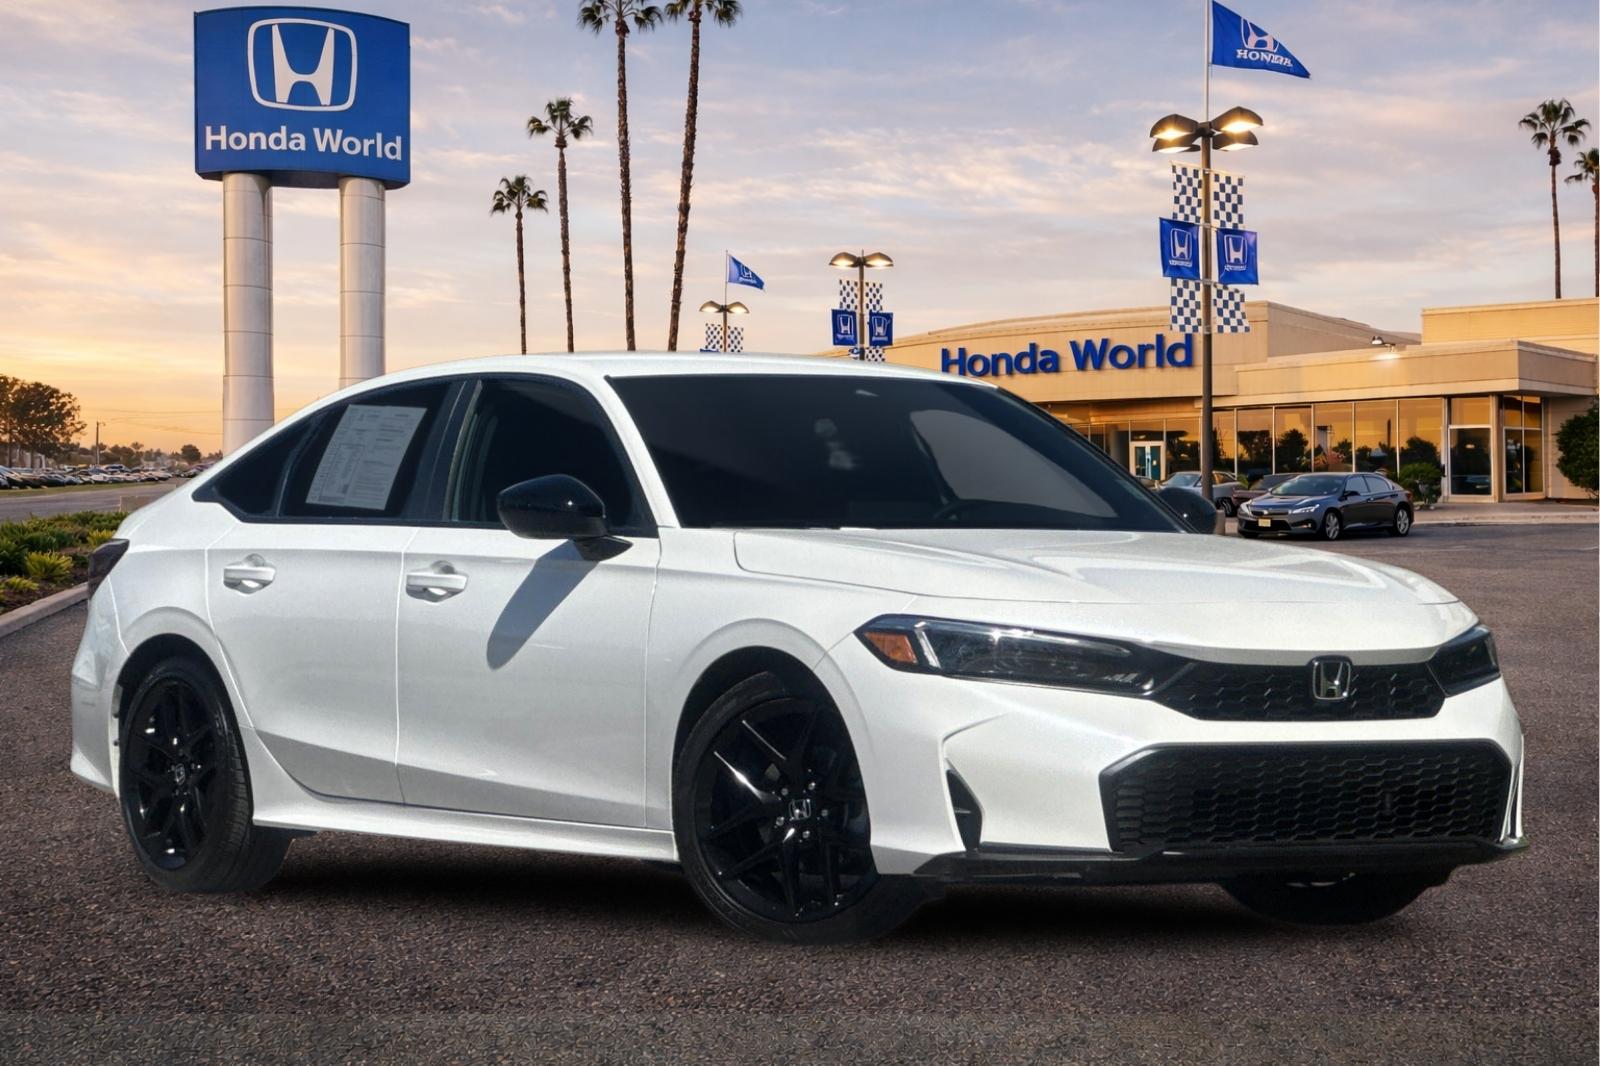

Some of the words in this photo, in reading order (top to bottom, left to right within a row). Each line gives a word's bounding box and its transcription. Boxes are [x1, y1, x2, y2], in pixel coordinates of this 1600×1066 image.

[205, 125, 306, 151] Honda
[312, 127, 402, 161] World
[941, 342, 1060, 377] Honda
[1069, 333, 1194, 371] World
